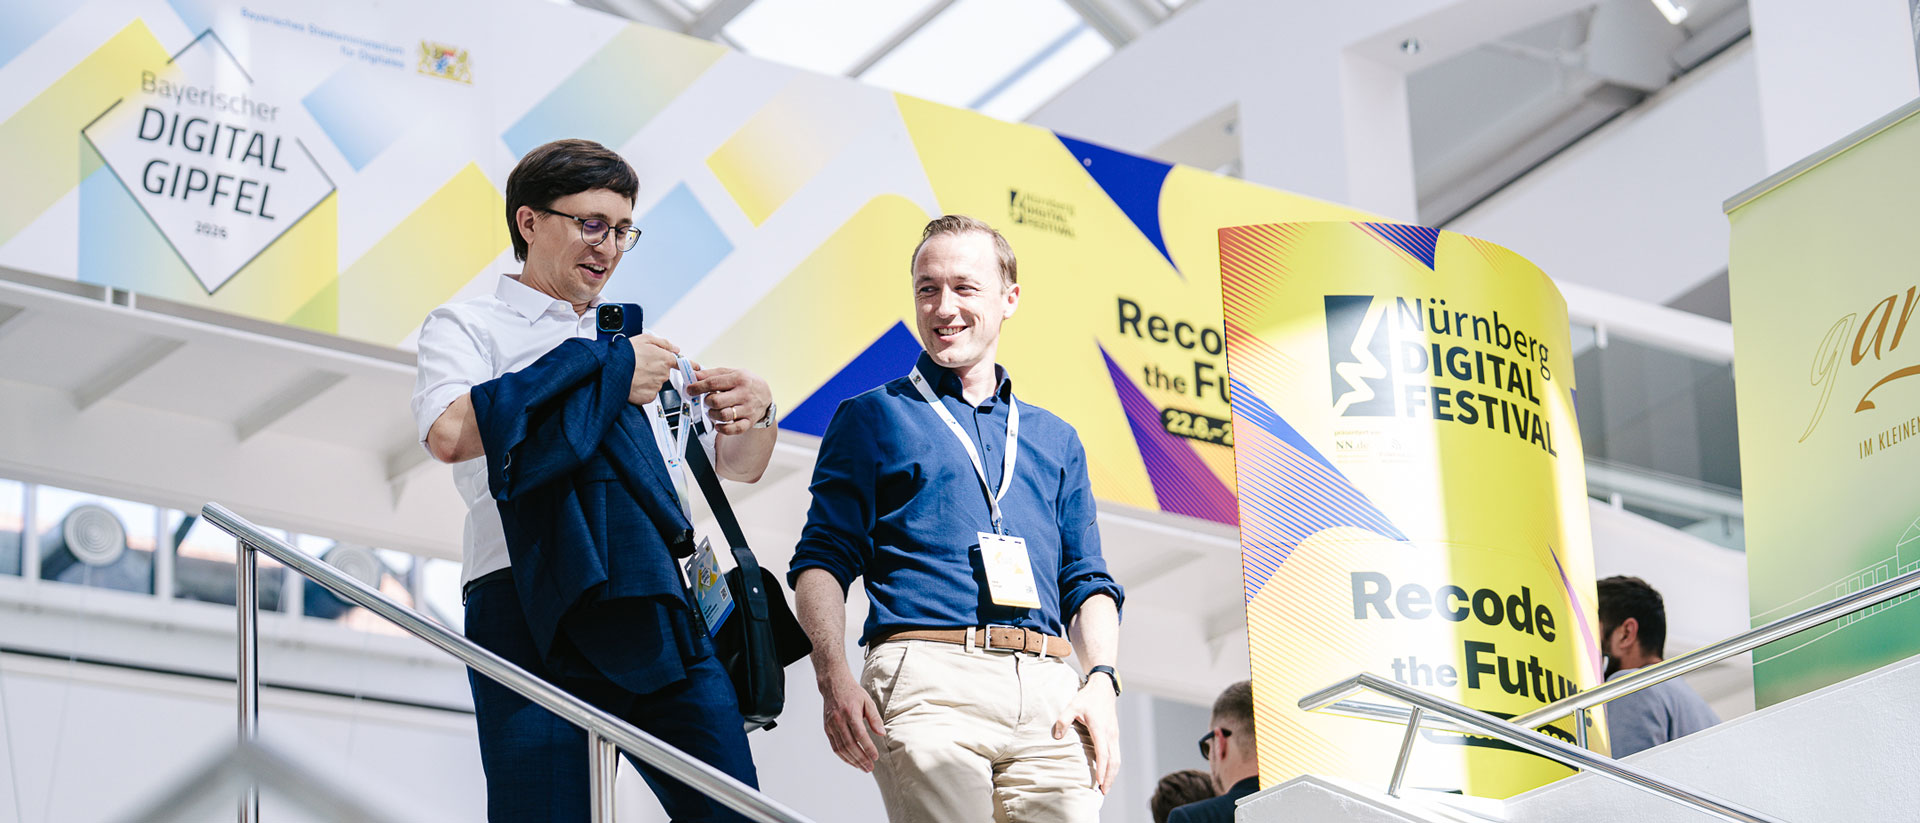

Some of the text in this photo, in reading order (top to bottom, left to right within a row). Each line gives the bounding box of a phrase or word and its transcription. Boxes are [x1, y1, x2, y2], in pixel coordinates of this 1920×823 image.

[142, 70, 280, 121] Bayerischer
[138, 106, 286, 172] DIGITAL
[143, 158, 275, 220] GIPFEL
[1118, 297, 1223, 355] Reco
[1396, 296, 1551, 381] Nürnberg
[1144, 365, 1187, 394] the
[1401, 341, 1541, 406] DIGITAL
[1404, 384, 1557, 458] FESTIVAL
[1859, 437, 1873, 459] IM
[1350, 571, 1556, 643] Recode
[1391, 639, 1592, 728] the Futur
